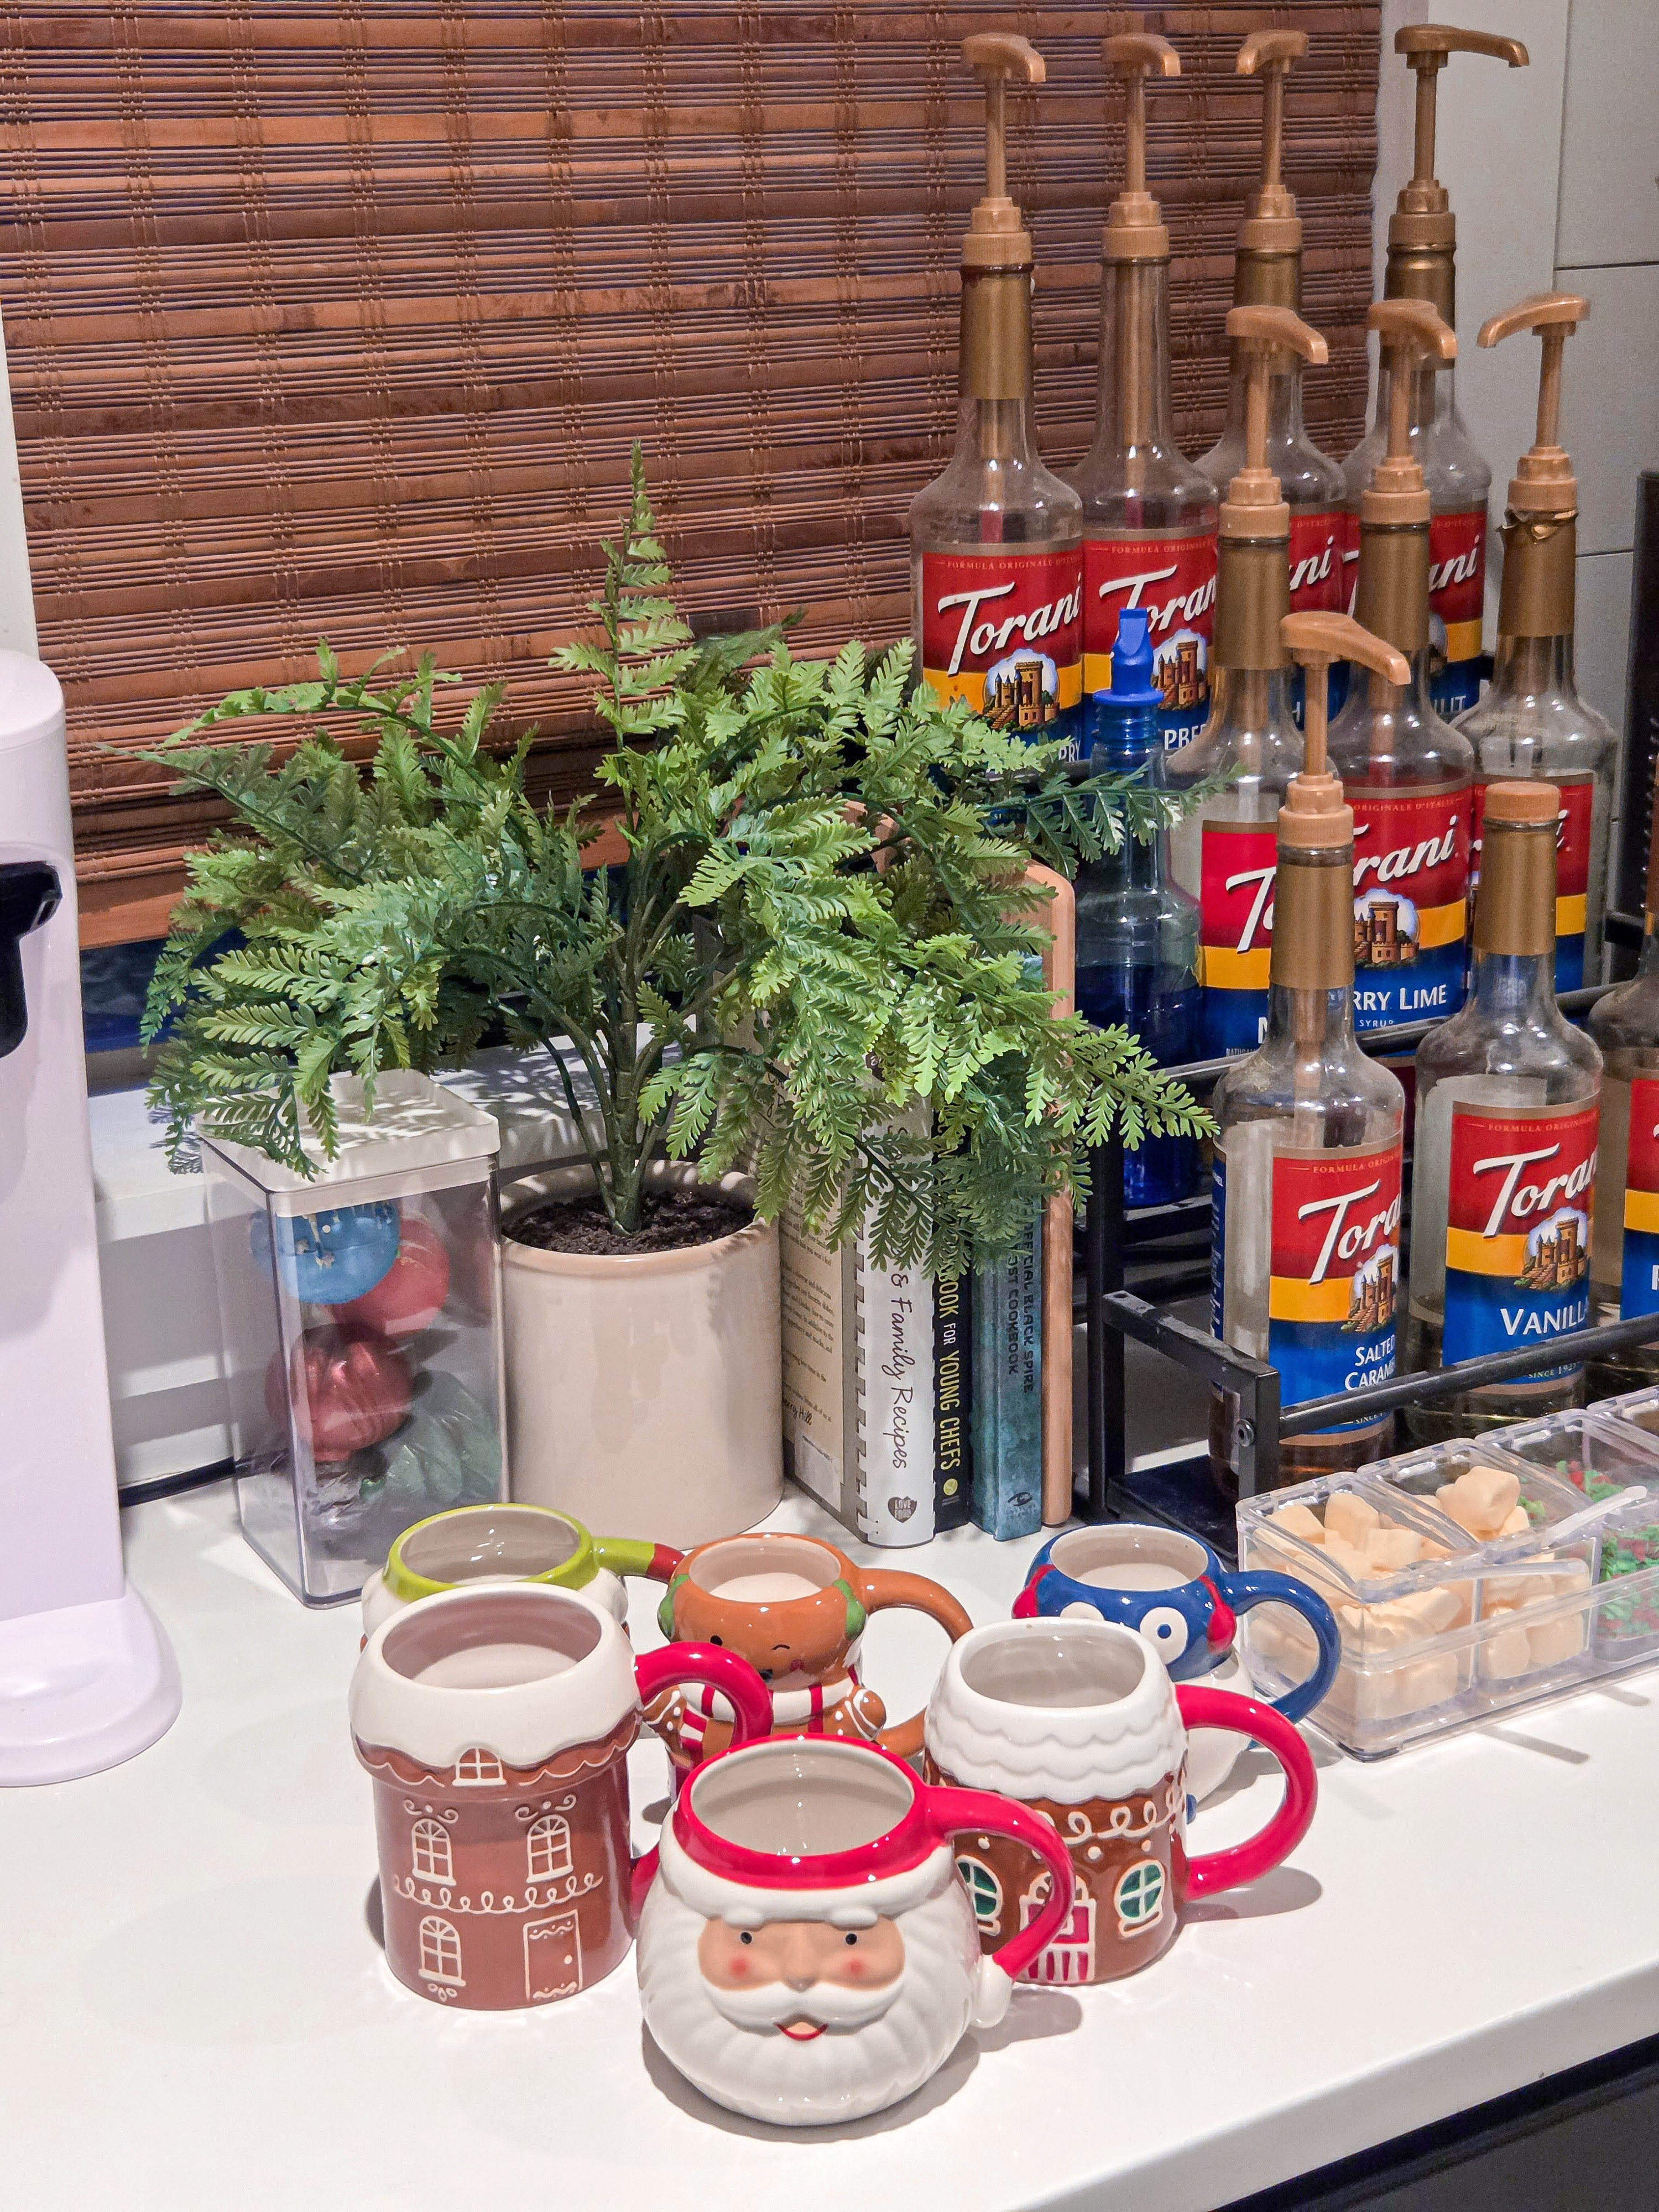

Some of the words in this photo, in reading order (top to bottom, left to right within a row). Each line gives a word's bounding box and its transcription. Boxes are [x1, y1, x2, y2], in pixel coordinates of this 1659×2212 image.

[947, 561, 995, 570] FORMULA
[937, 571, 1082, 677] Torani
[1353, 814, 1458, 886] rani
[1359, 1019, 1394, 1027] SYRUP
[1488, 1124, 1541, 1133] FORMULA
[1313, 1164, 1364, 1173] FORMULA
[1473, 1142, 1598, 1238] Toran
[1298, 1178, 1401, 1285] Tora
[891, 1273, 909, 1288] &
[881, 1297, 915, 1380] Family
[943, 1322, 956, 1345] FOR
[1008, 1289, 1019, 1375] COOKBOOK
[1024, 1294, 1034, 1347] BLACK
[1024, 1350, 1034, 1394] SPIRE
[1355, 1334, 1395, 1366] SALTED
[940, 1349, 960, 1411] YOUNG
[883, 1386, 913, 1469] Recipes
[940, 1417, 961, 1470] CHEFS
[894, 1499, 911, 1509] LOVE
